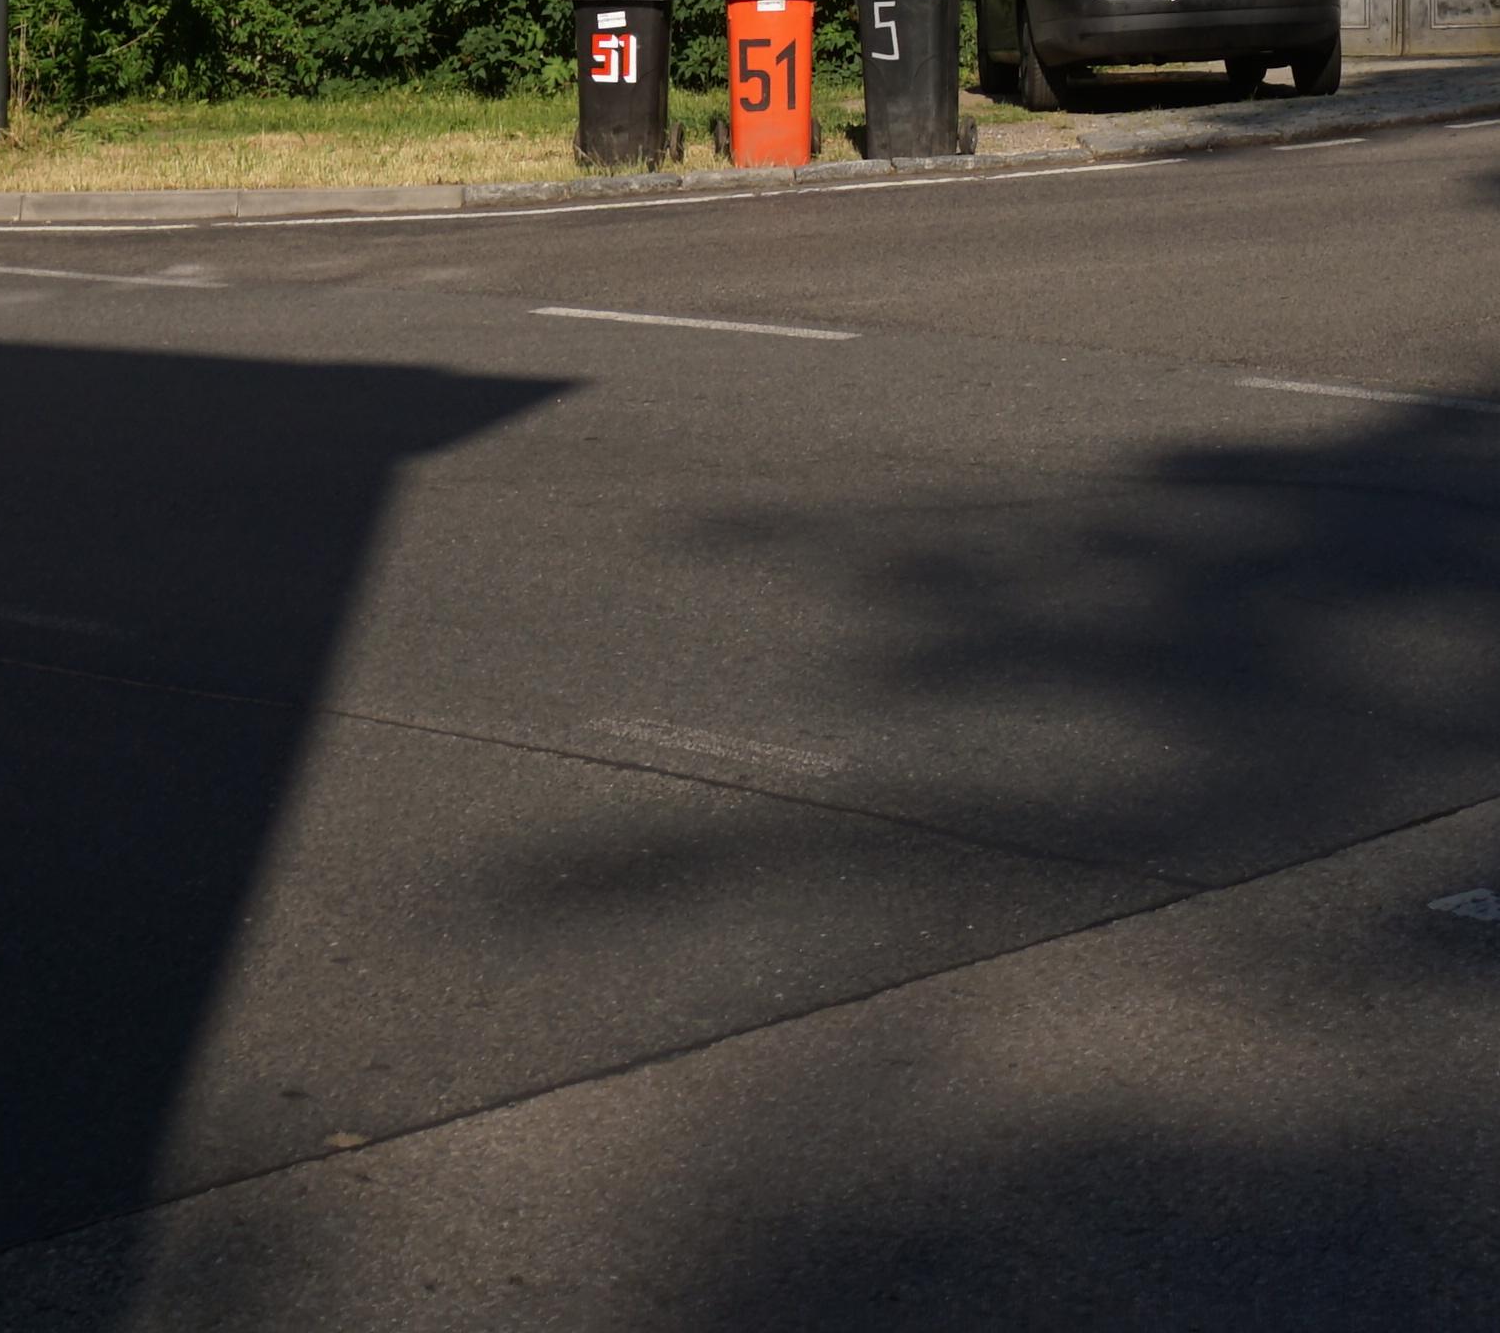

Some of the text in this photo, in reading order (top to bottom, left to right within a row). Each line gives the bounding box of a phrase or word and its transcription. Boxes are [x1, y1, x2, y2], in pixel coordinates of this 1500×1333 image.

[591, 33, 637, 83] 51
[871, 1, 900, 60] 5
[739, 38, 796, 112] 51
